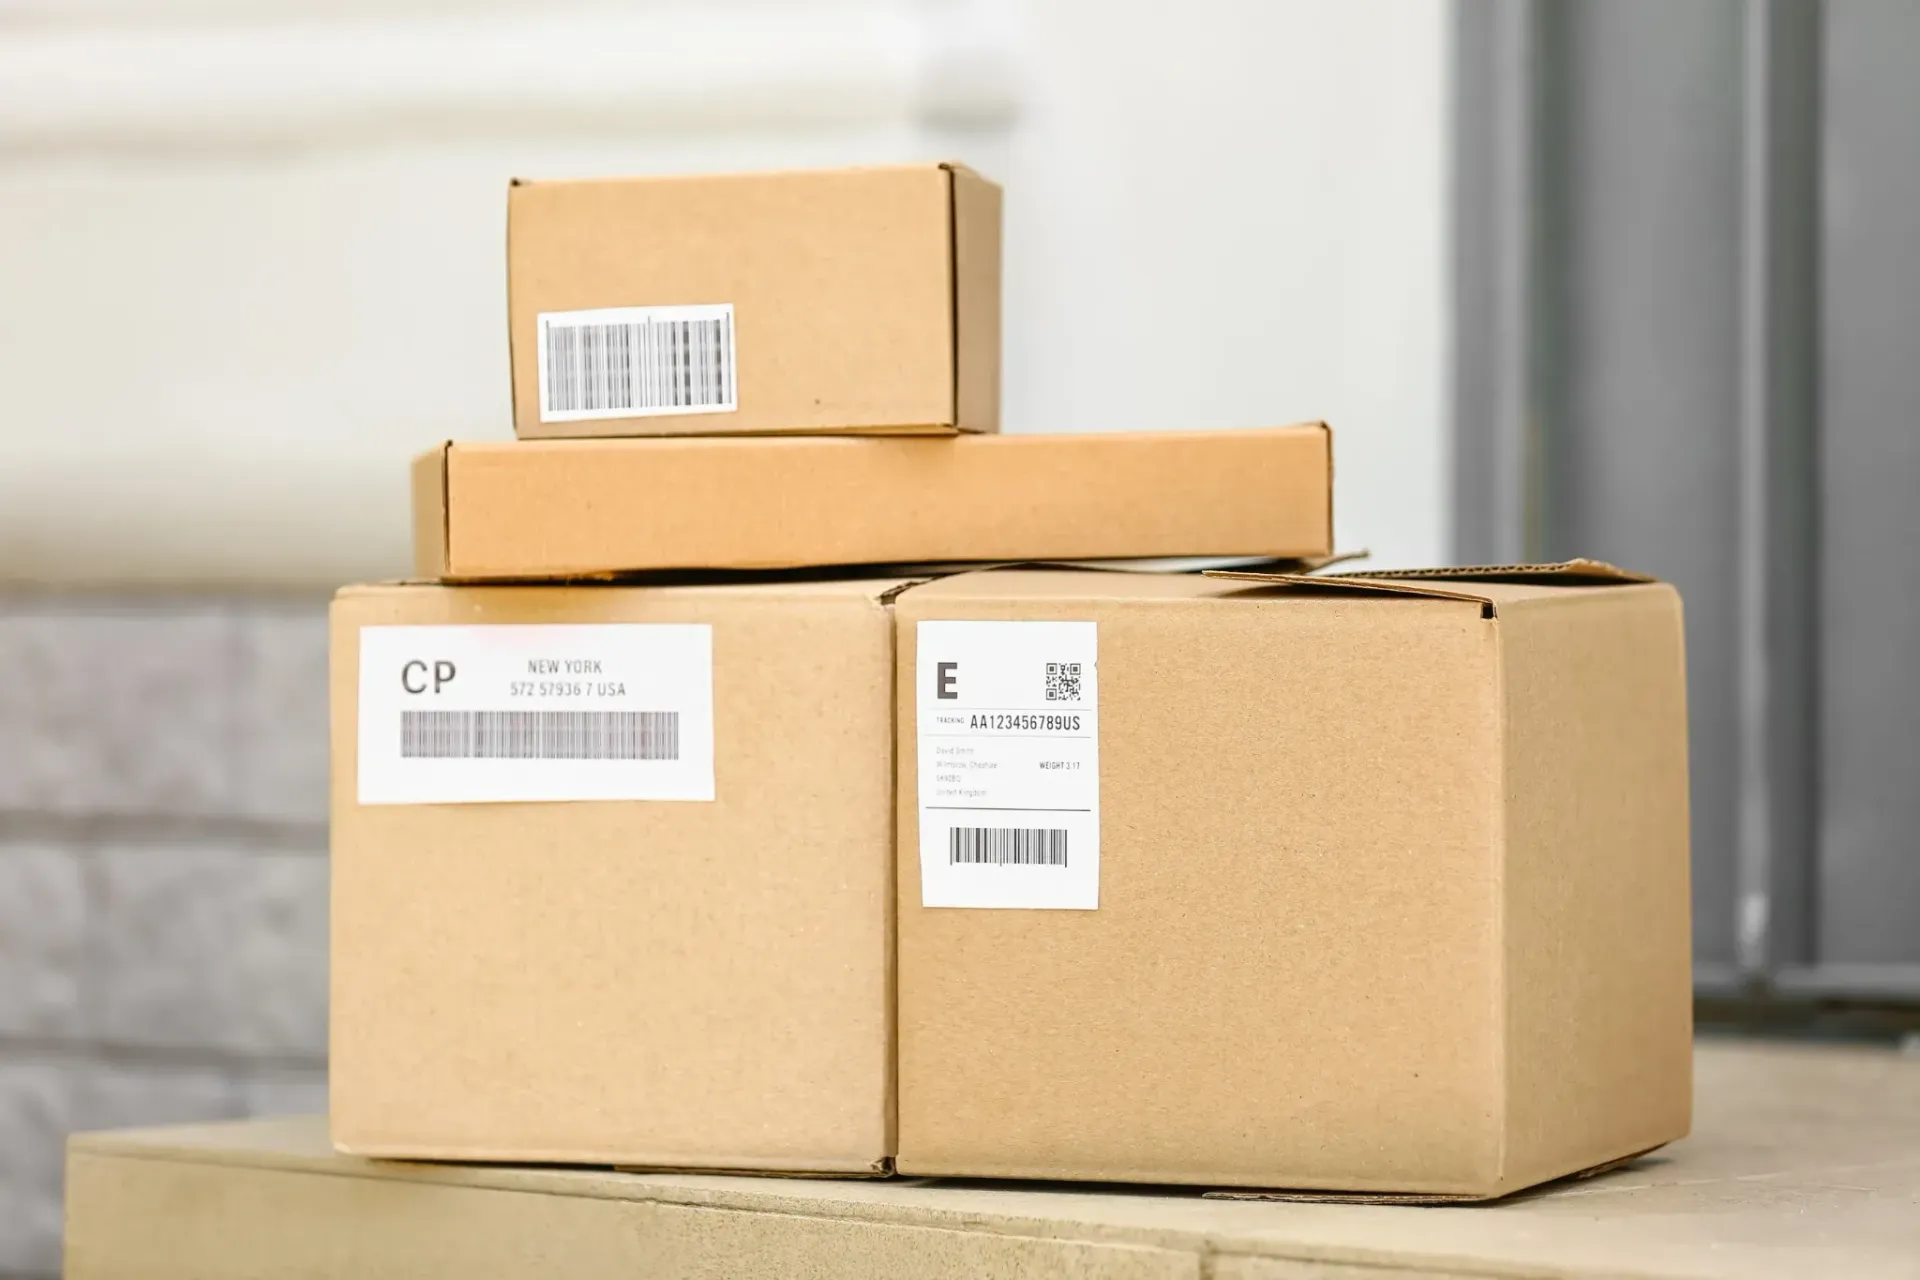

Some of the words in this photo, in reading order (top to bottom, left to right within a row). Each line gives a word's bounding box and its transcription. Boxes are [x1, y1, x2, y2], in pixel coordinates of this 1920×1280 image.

[527, 659, 559, 674] NEW
[564, 659, 602, 674] YORK
[401, 660, 456, 694] CP
[937, 661, 958, 700] E
[510, 682, 534, 697] 572
[539, 682, 581, 697] 57936
[586, 682, 593, 697] 7
[597, 682, 626, 697] USA
[936, 716, 965, 725] TRACKING
[971, 715, 1080, 730] AA123456789US
[1039, 761, 1064, 770] WEIGHT
